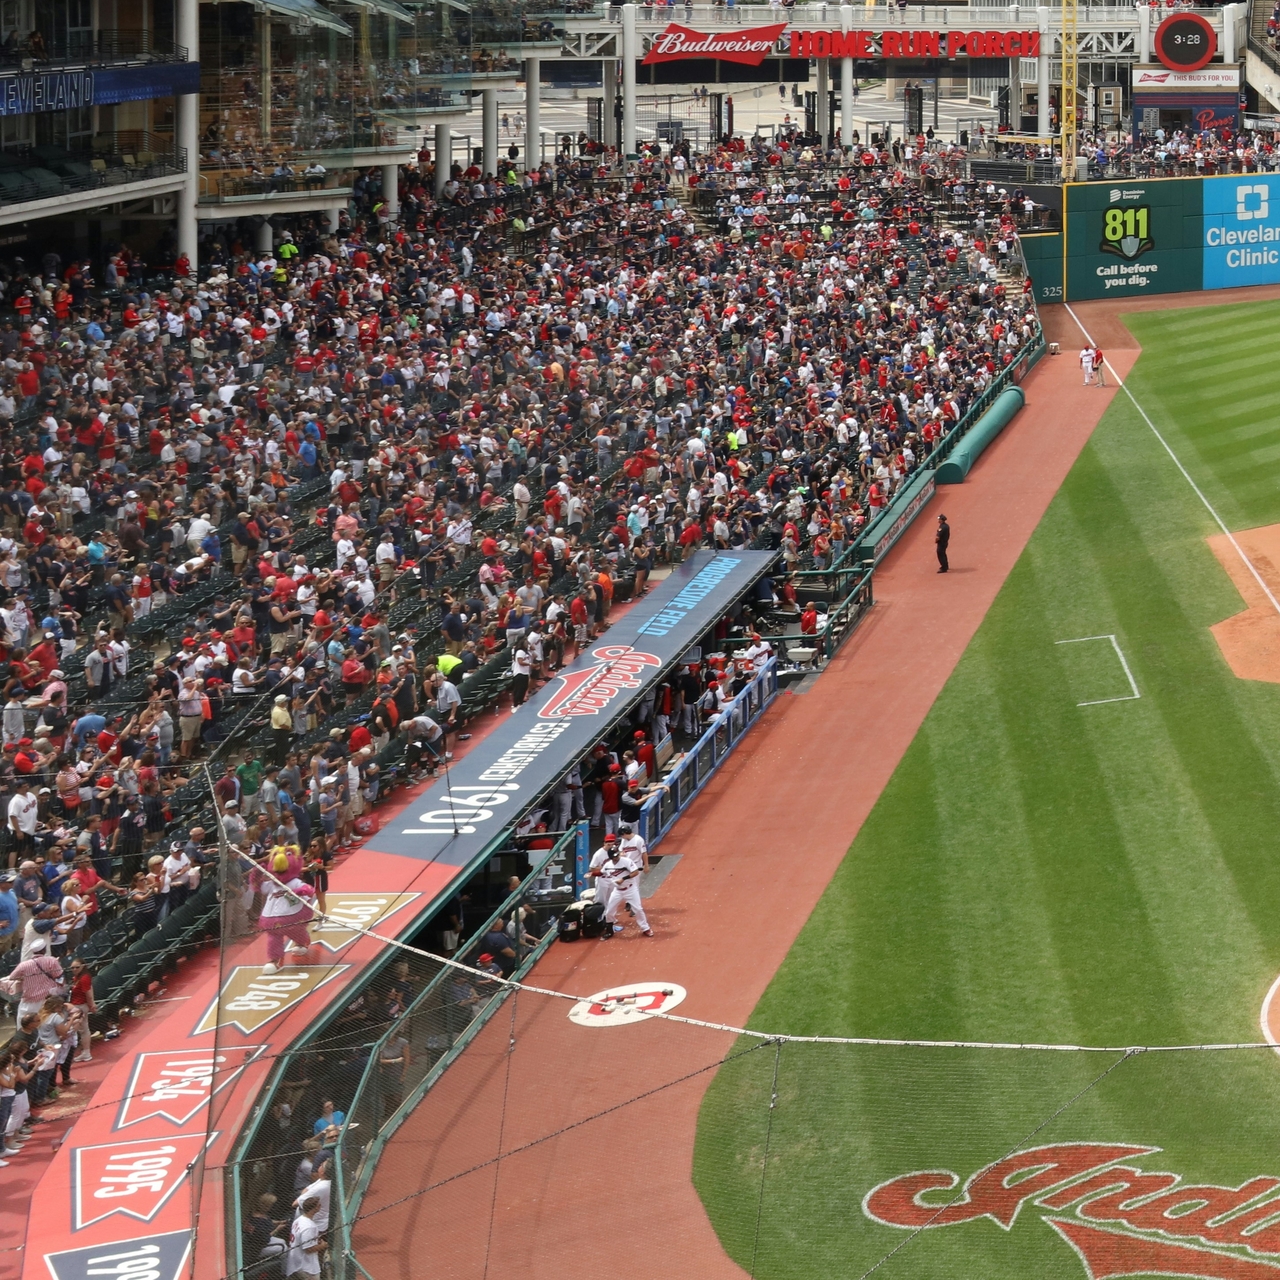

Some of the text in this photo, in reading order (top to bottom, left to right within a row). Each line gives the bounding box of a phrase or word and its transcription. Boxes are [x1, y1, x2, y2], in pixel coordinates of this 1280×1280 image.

[654, 32, 773, 54] Budweiser
[791, 30, 1040, 58] HOME RUN PORCH
[1174, 34, 1201, 45] 3:28
[1104, 207, 1148, 240] 811
[1096, 262, 1158, 276] Call before
[1226, 248, 1279, 269] Clinic
[1042, 286, 1062, 298] 325
[1104, 274, 1150, 289] you dig.
[226, 972, 310, 1012] 1948
[93, 1145, 177, 1199] 1995
